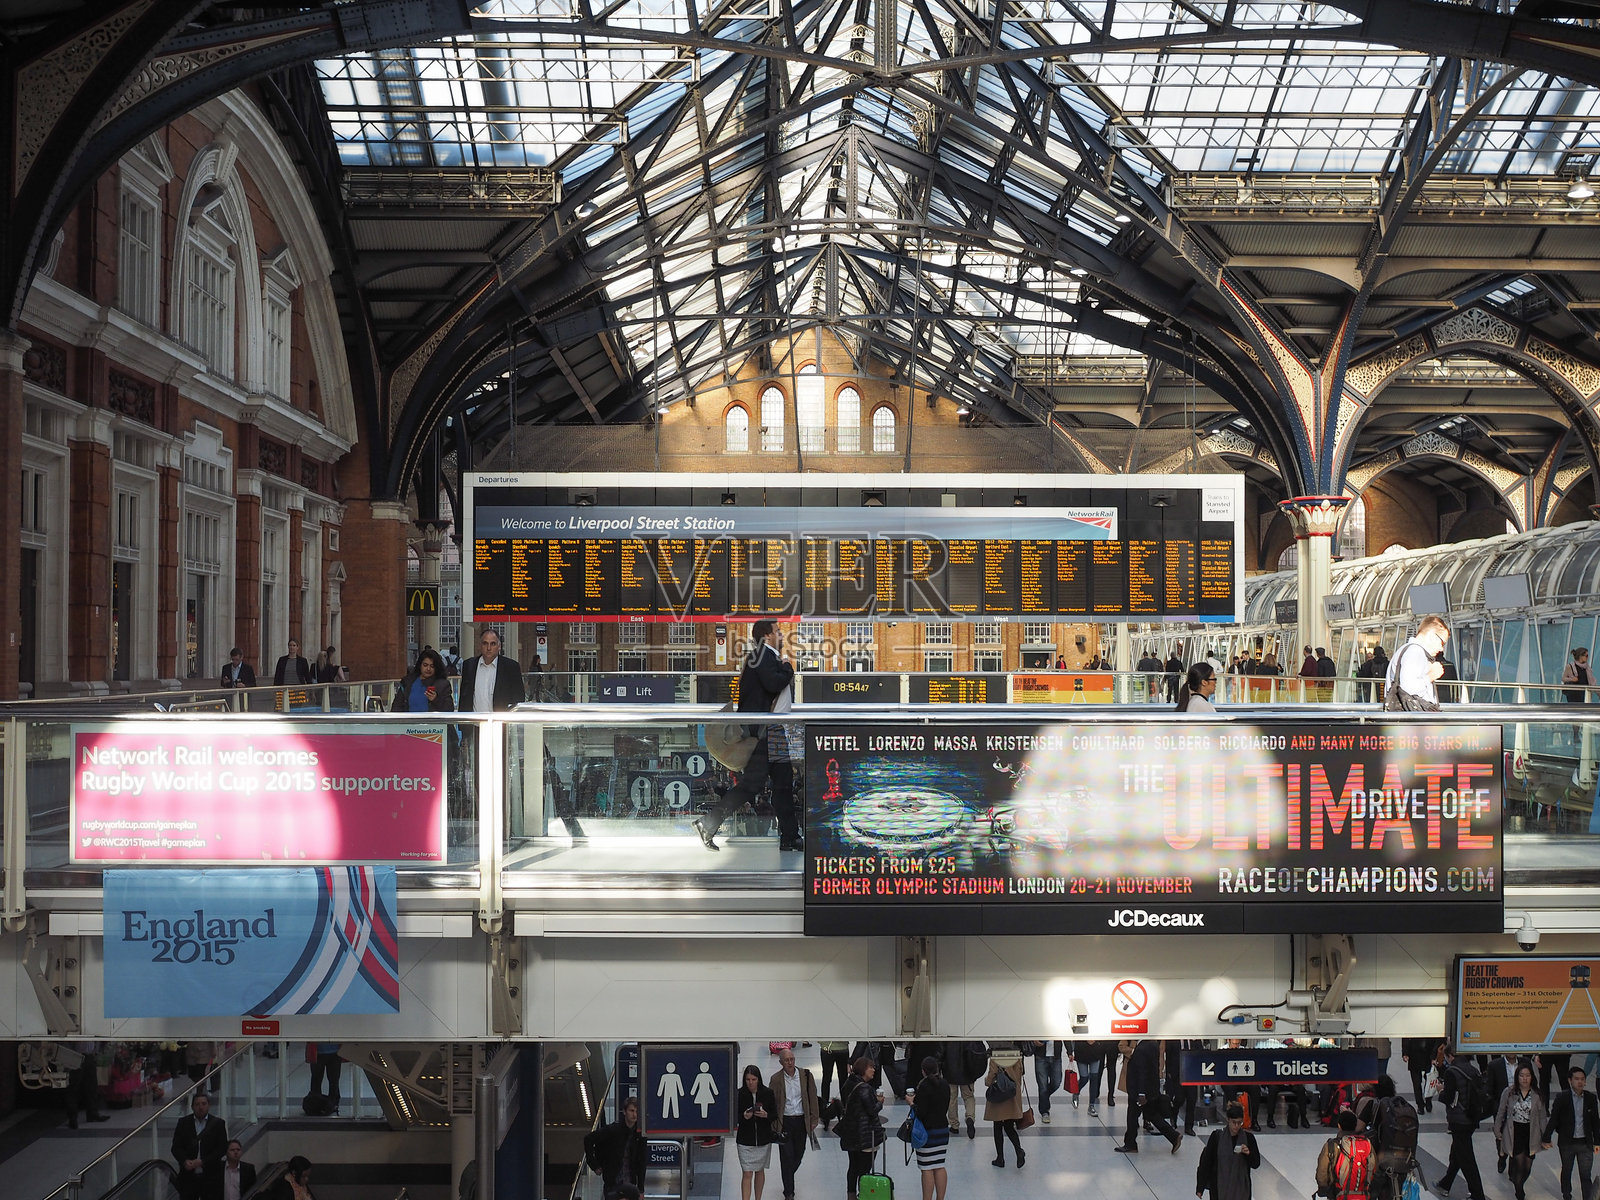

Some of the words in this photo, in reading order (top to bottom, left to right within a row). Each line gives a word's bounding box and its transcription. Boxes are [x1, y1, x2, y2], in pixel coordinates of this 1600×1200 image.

[478, 476, 519, 484] Departures
[1208, 508, 1229, 516] Airport
[500, 517, 552, 529] Welcome
[554, 518, 566, 529] to
[569, 516, 634, 533] Liverpool
[636, 516, 680, 530] Street
[683, 516, 736, 530] Station
[636, 686, 652, 697] Lift
[815, 736, 860, 751] VETTEL
[869, 736, 926, 751] LORENZO
[933, 736, 978, 751] MASSA
[986, 736, 1064, 751] KRISTENSEN
[1072, 736, 1145, 751] COULTHARD
[1153, 736, 1211, 751] SOLBERG
[1219, 736, 1287, 751] RICCIARDO
[1291, 736, 1316, 751] AND
[1321, 736, 1355, 751] MANY
[1359, 736, 1394, 751] MORE
[1399, 736, 1419, 751] BIG
[1423, 736, 1463, 751] STARS
[82, 746, 169, 767] Network
[175, 746, 213, 767] Rail
[218, 746, 319, 767] welcomes
[82, 771, 146, 796] Rugby
[151, 771, 213, 792] World
[218, 771, 259, 796] Cup
[265, 771, 317, 792] 2015
[320, 773, 437, 796] supporters.
[1119, 764, 1164, 793] THE
[1163, 762, 1495, 851] ULTIMATE
[1350, 788, 1491, 820] DRIVE-OFF
[82, 820, 198, 832] rugbyworldcup.com/gameplan
[92, 836, 161, 849] @RWC2015Travel
[161, 837, 207, 849] #gameplan
[814, 856, 876, 875] TICKETS
[880, 856, 923, 875] FROM
[929, 856, 956, 875] £25
[813, 877, 871, 896] FORMER
[876, 877, 938, 896] OLYMPIC
[942, 877, 1005, 896] STADIUM
[1008, 877, 1066, 896] LONDON
[1069, 877, 1110, 895] 20-21
[1116, 876, 1193, 895] NOVEMBER
[1218, 866, 1495, 894] RACEOFCHAMPIONS.COM
[121, 907, 278, 943] England
[1107, 909, 1205, 928] JCDecaux
[150, 939, 236, 966] 2015
[1465, 964, 1485, 977] BEAT
[1486, 964, 1499, 977] THE
[1465, 976, 1490, 989] RUGBY
[1491, 976, 1524, 989] CROWDS
[1481, 990, 1516, 998] September
[1272, 1060, 1329, 1077] Toilets
[651, 1154, 675, 1162] Street
